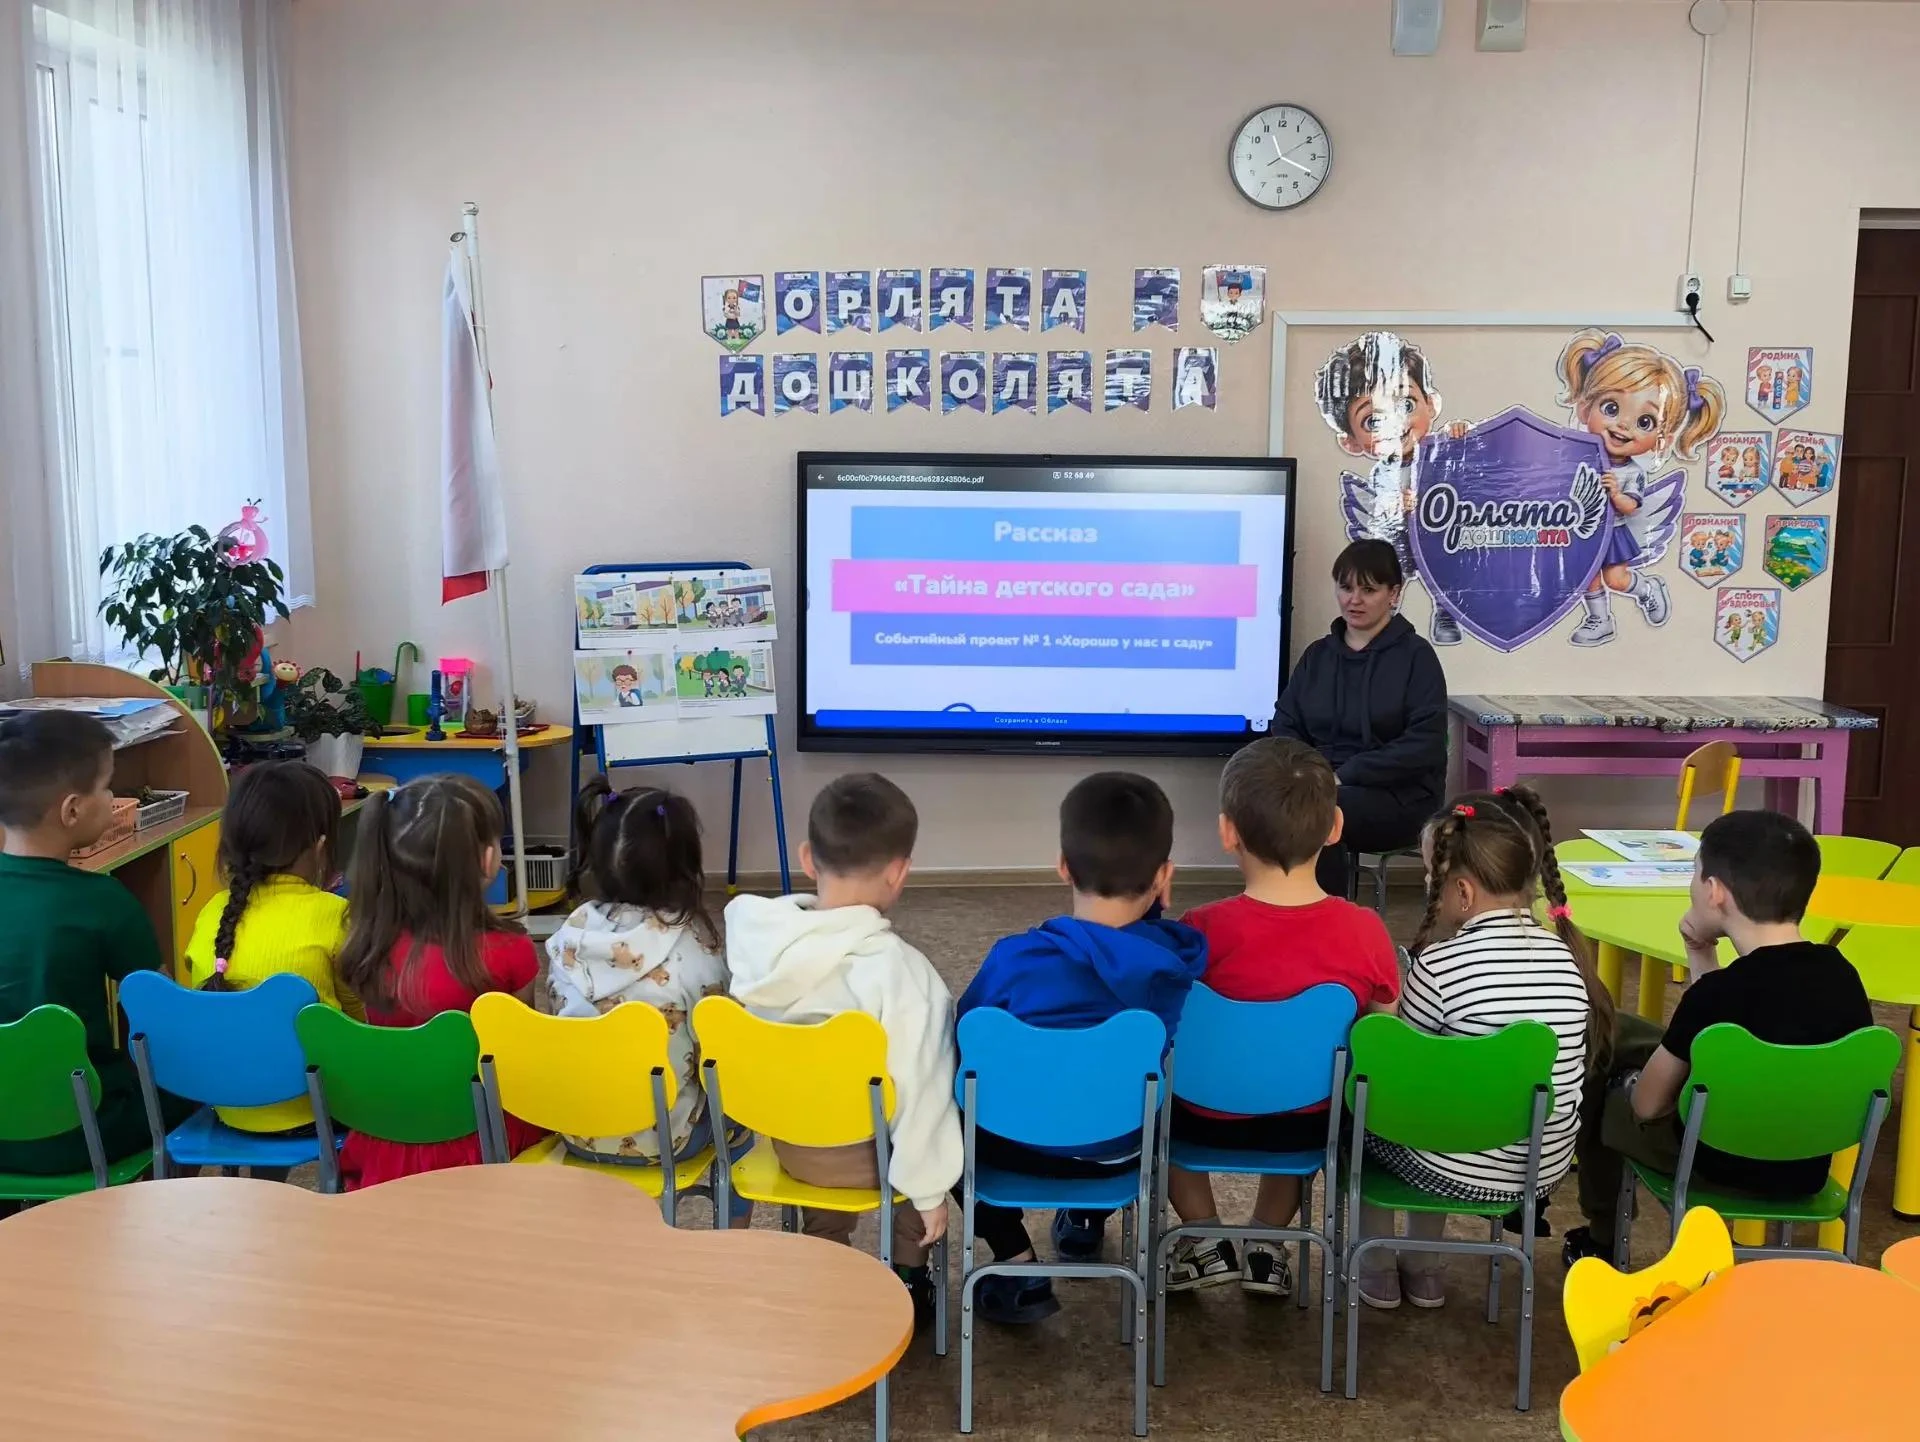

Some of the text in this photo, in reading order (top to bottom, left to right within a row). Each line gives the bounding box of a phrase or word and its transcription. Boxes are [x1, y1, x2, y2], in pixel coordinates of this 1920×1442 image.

[1278, 120, 1287, 128] 12
[1263, 125, 1270, 133] 11
[1251, 136, 1261, 144] 10
[1306, 136, 1313, 144] 2
[1310, 153, 1317, 161] 3
[1292, 181, 1299, 189] 5
[1276, 186, 1283, 194] 6
[784, 287, 1079, 319] ОРЛЯТА
[1760, 351, 1800, 360] РОДИНА
[727, 366, 1210, 411] ДОШКОЛЯТА
[1716, 436, 1764, 445] КОМАНДА
[1794, 435, 1825, 446] СЕМЬЯ
[1421, 486, 1577, 551] Орлята
[1688, 518, 1739, 526] ПОЗНАНИЕ
[1776, 519, 1821, 528] ПРИРОДА
[994, 521, 1099, 543] Рассказ
[1459, 529, 1569, 547] ДОШКОЛЯТА
[895, 574, 1195, 601] «Тайна детского сада»
[1734, 592, 1764, 600] СПОРТ
[1730, 600, 1777, 609] ЗДОРОВЬЕ
[875, 632, 1213, 651] Событийный проект № 1 «Хорошо у нас в саду»
